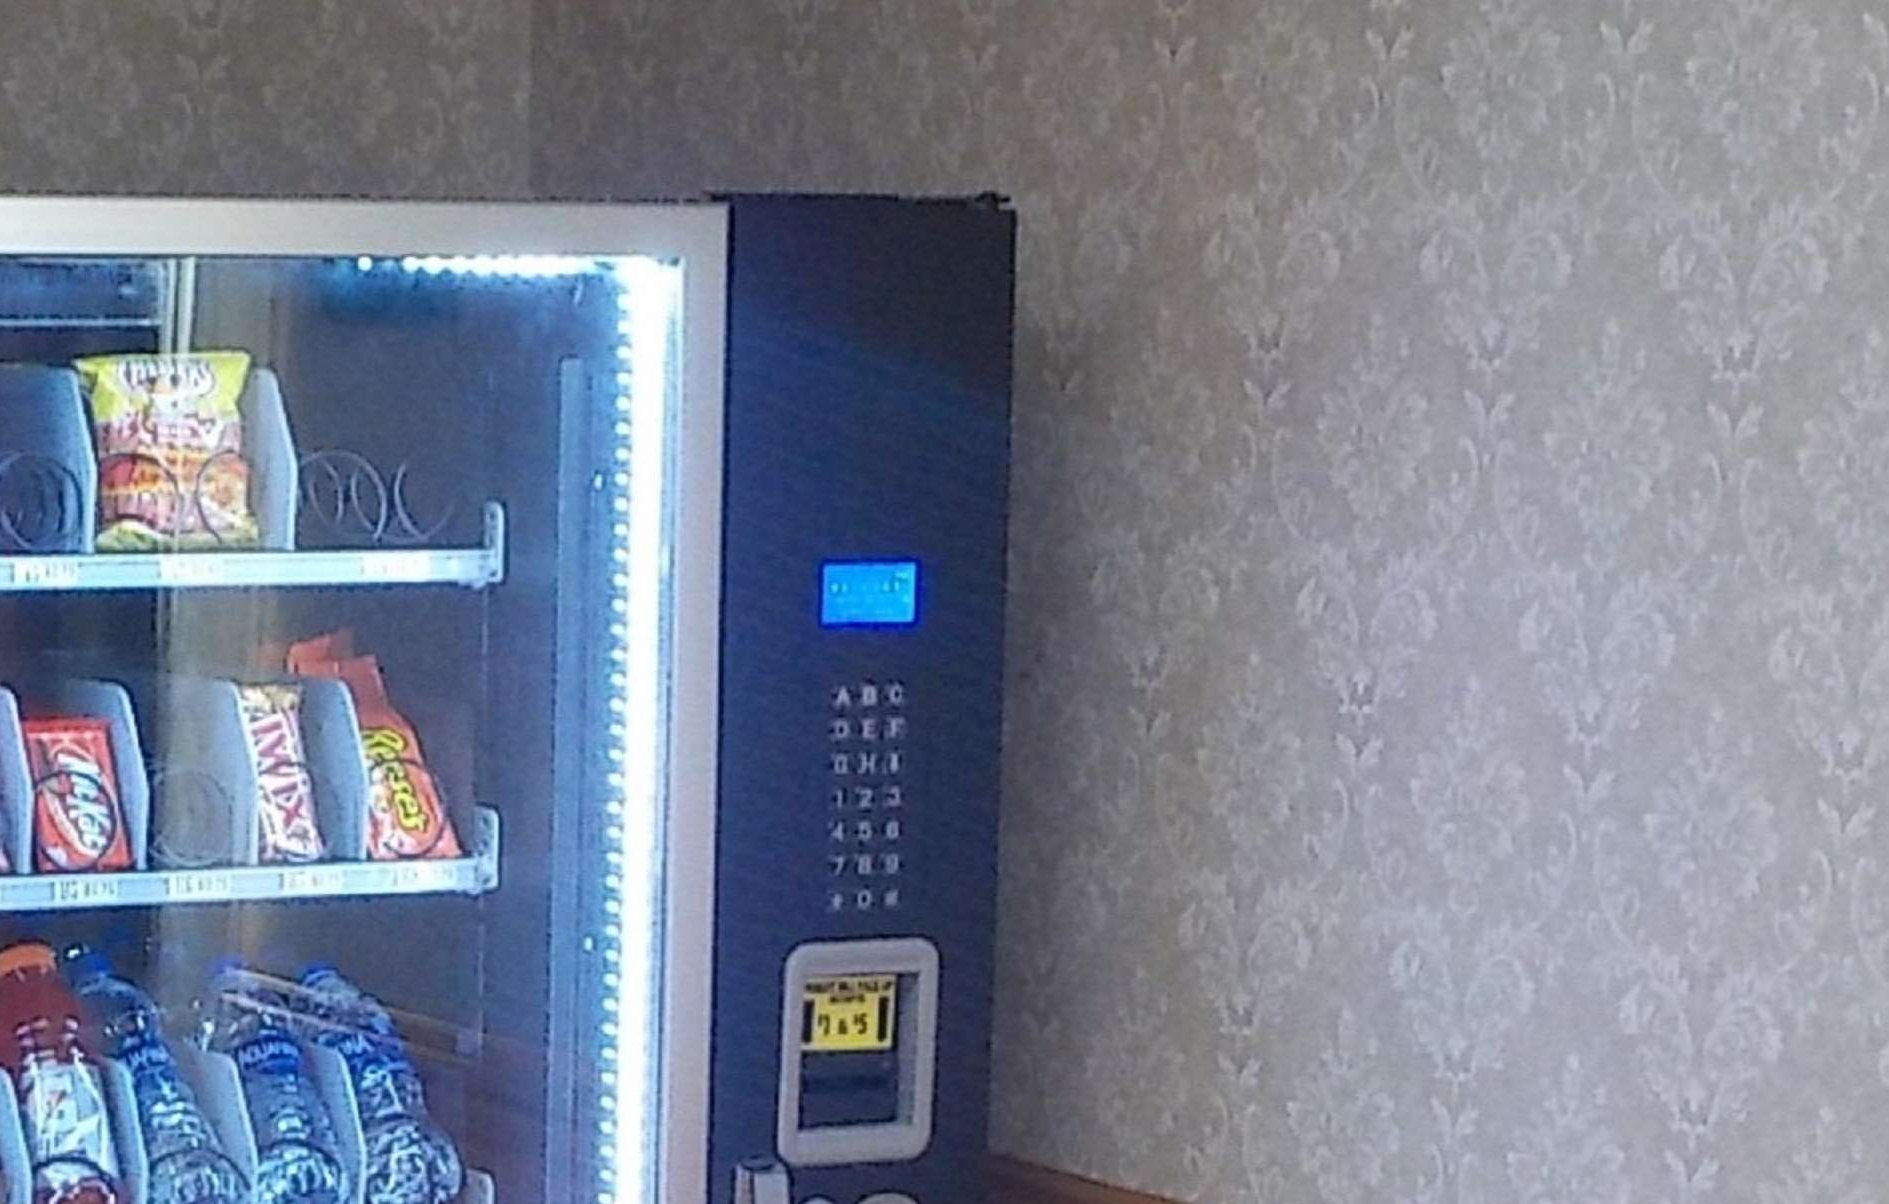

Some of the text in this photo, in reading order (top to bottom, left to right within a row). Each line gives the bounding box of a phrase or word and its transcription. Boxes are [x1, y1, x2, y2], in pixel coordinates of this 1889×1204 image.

[836, 683, 903, 706] A B C
[834, 716, 905, 738] D E F
[859, 753, 877, 774] H
[835, 785, 901, 809] 1 2 3
[831, 820, 899, 842] 4 5 6
[832, 853, 899, 875] 7 8 9
[857, 889, 872, 910] 0
